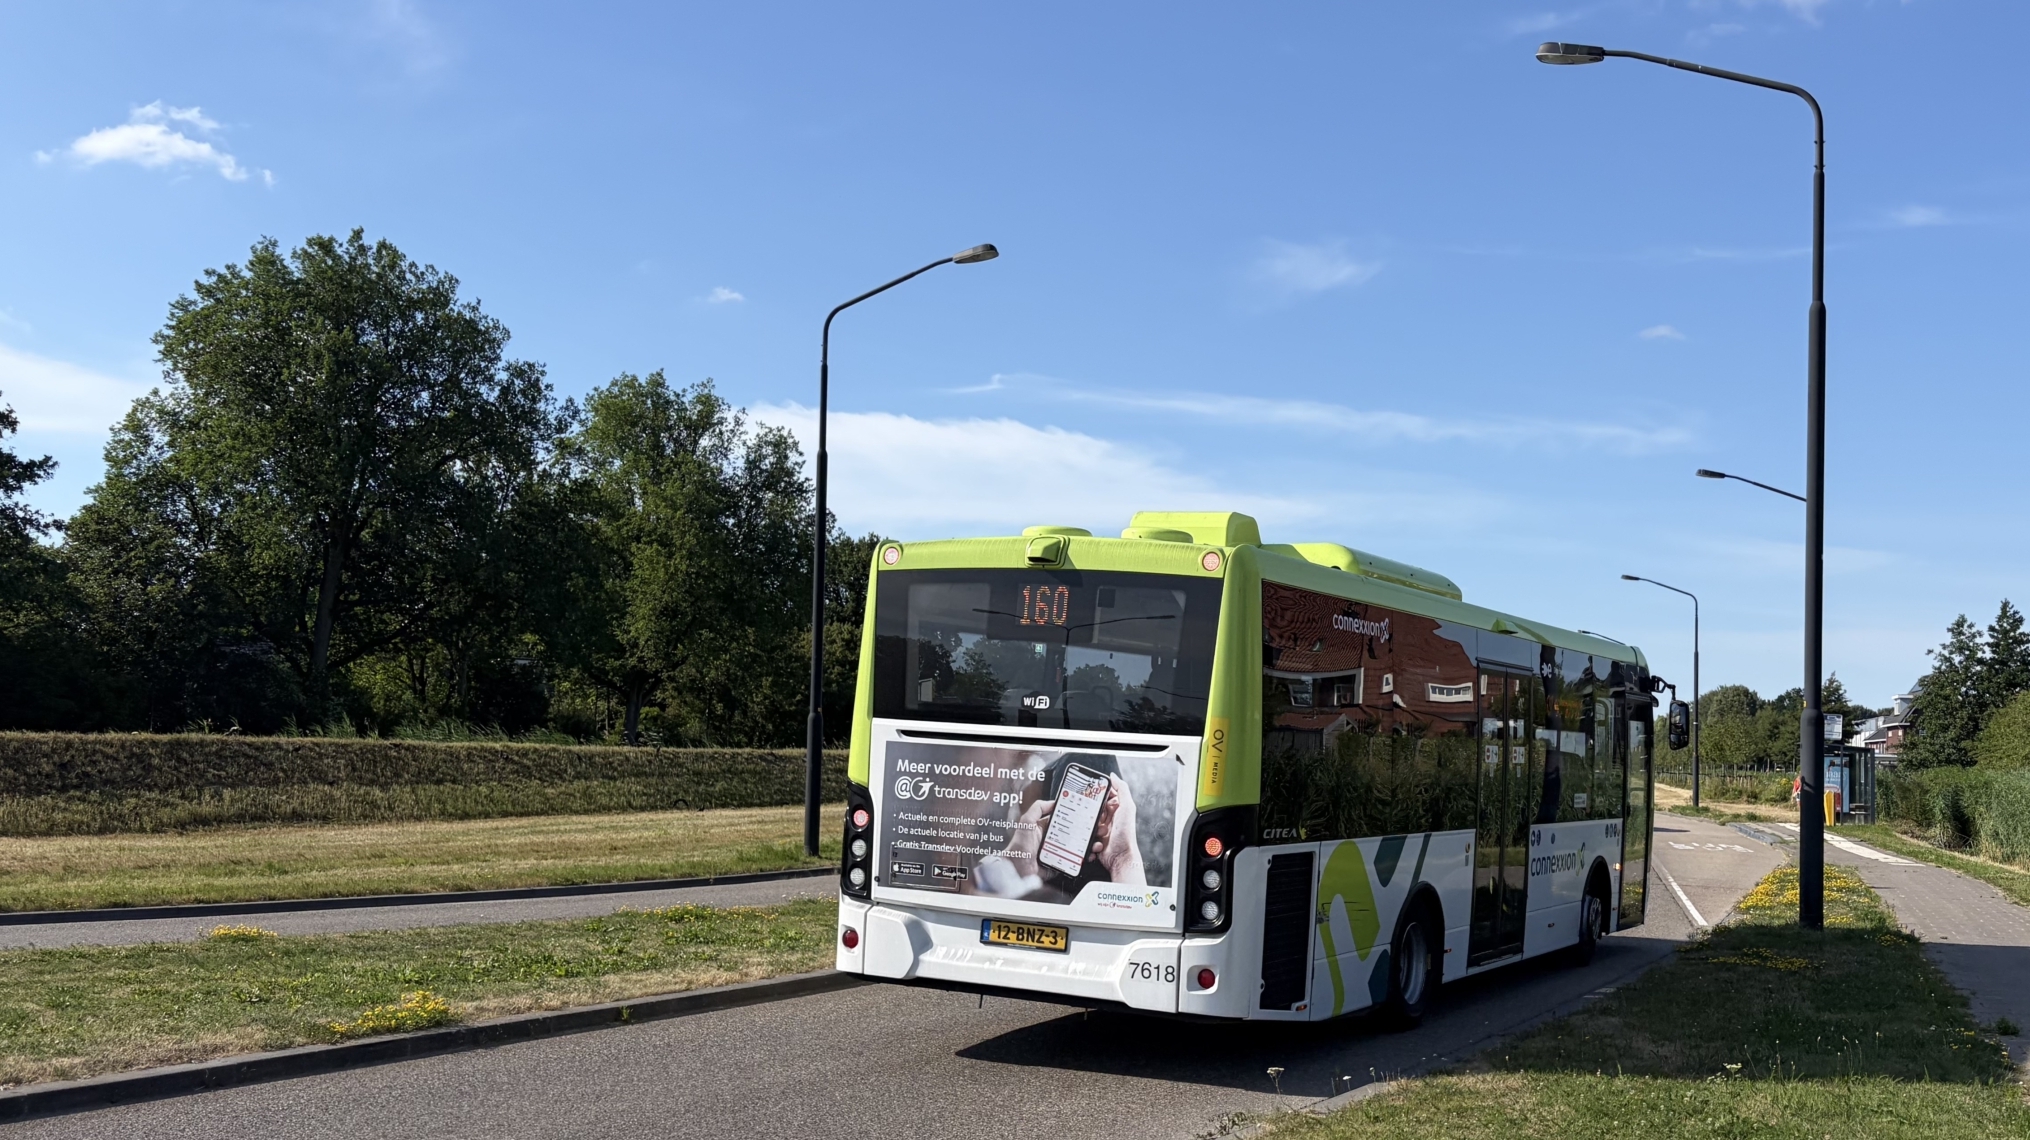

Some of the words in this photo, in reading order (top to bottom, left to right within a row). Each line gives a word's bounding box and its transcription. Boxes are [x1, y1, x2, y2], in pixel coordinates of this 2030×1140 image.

[1020, 586, 1069, 625] 160
[1333, 613, 1380, 637] connexxion
[1212, 729, 1224, 752] OV
[896, 759, 931, 773] Meer
[933, 762, 994, 778] voordeel
[997, 767, 1025, 780] met
[1027, 767, 1046, 782] de
[1211, 762, 1219, 784] MEDIA
[934, 785, 990, 801] transdev
[992, 791, 1024, 806] app!
[898, 811, 927, 822] Actuele
[928, 814, 938, 823] en
[939, 815, 976, 826] complete
[976, 817, 1038, 830] OV-reisplanner
[898, 825, 909, 834] De
[909, 827, 937, 837] actuele
[938, 828, 965, 839] locatie
[965, 832, 980, 840] van
[980, 833, 989, 842] je
[989, 833, 1004, 842] bus
[1263, 828, 1297, 839] CITEA
[897, 840, 920, 849] Gratis
[920, 841, 955, 852] Transdev
[956, 844, 991, 856] Voordeel
[992, 848, 1032, 859] aanzetten
[1530, 852, 1576, 877] connexxion
[1097, 892, 1144, 903] connexxion
[996, 924, 1058, 946] 12-BNZ-3
[1129, 962, 1176, 983] 7618
